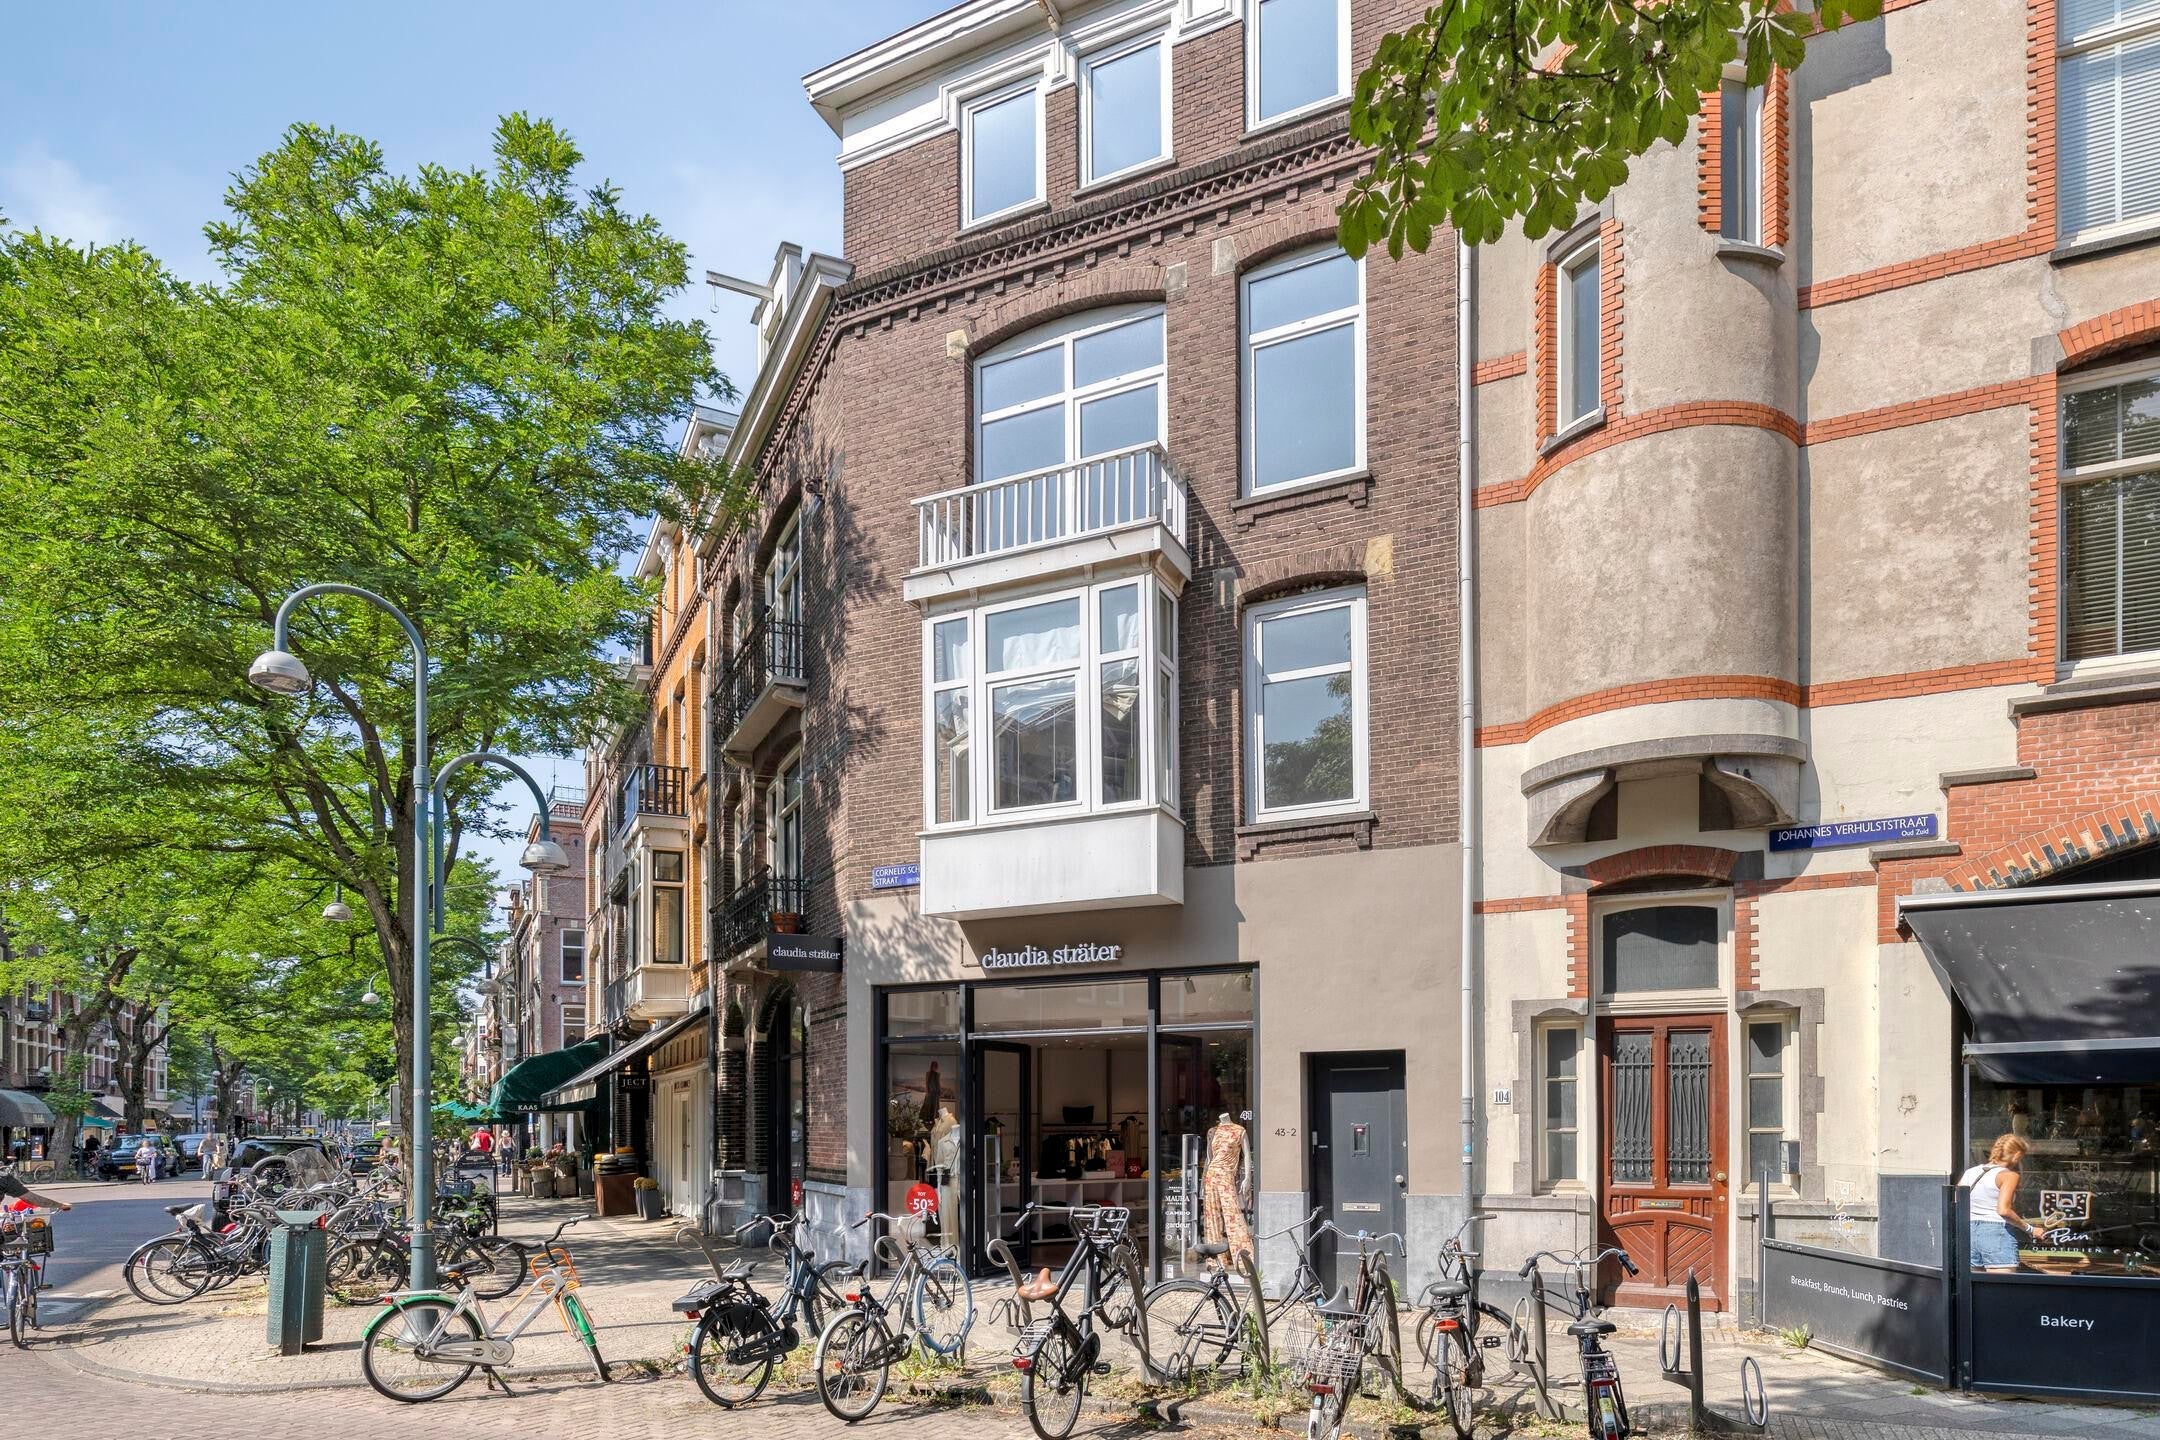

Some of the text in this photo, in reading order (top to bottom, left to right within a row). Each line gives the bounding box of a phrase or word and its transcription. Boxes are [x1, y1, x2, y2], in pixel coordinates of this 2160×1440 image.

[1778, 816, 1929, 842] JOHANNES VERHULSTSTRAAT
[1915, 828, 1929, 836] Zuid
[875, 866, 906, 877] CORNELIS
[875, 877, 899, 886] STRAAT
[772, 946, 841, 960] claudia sträter
[982, 942, 1122, 969] claudia sträter
[621, 1078, 647, 1087] JECT
[1494, 1090, 1510, 1103] 104
[1240, 1110, 1253, 1120] 41
[1274, 1127, 1297, 1137] 43-2
[909, 1198, 934, 1210] -50%
[2042, 1227, 2089, 1246] Pain
[1790, 1275, 1908, 1311] Breakfast, Brunch, Lunch, Pastries
[2040, 1315, 2094, 1331] Bakery
